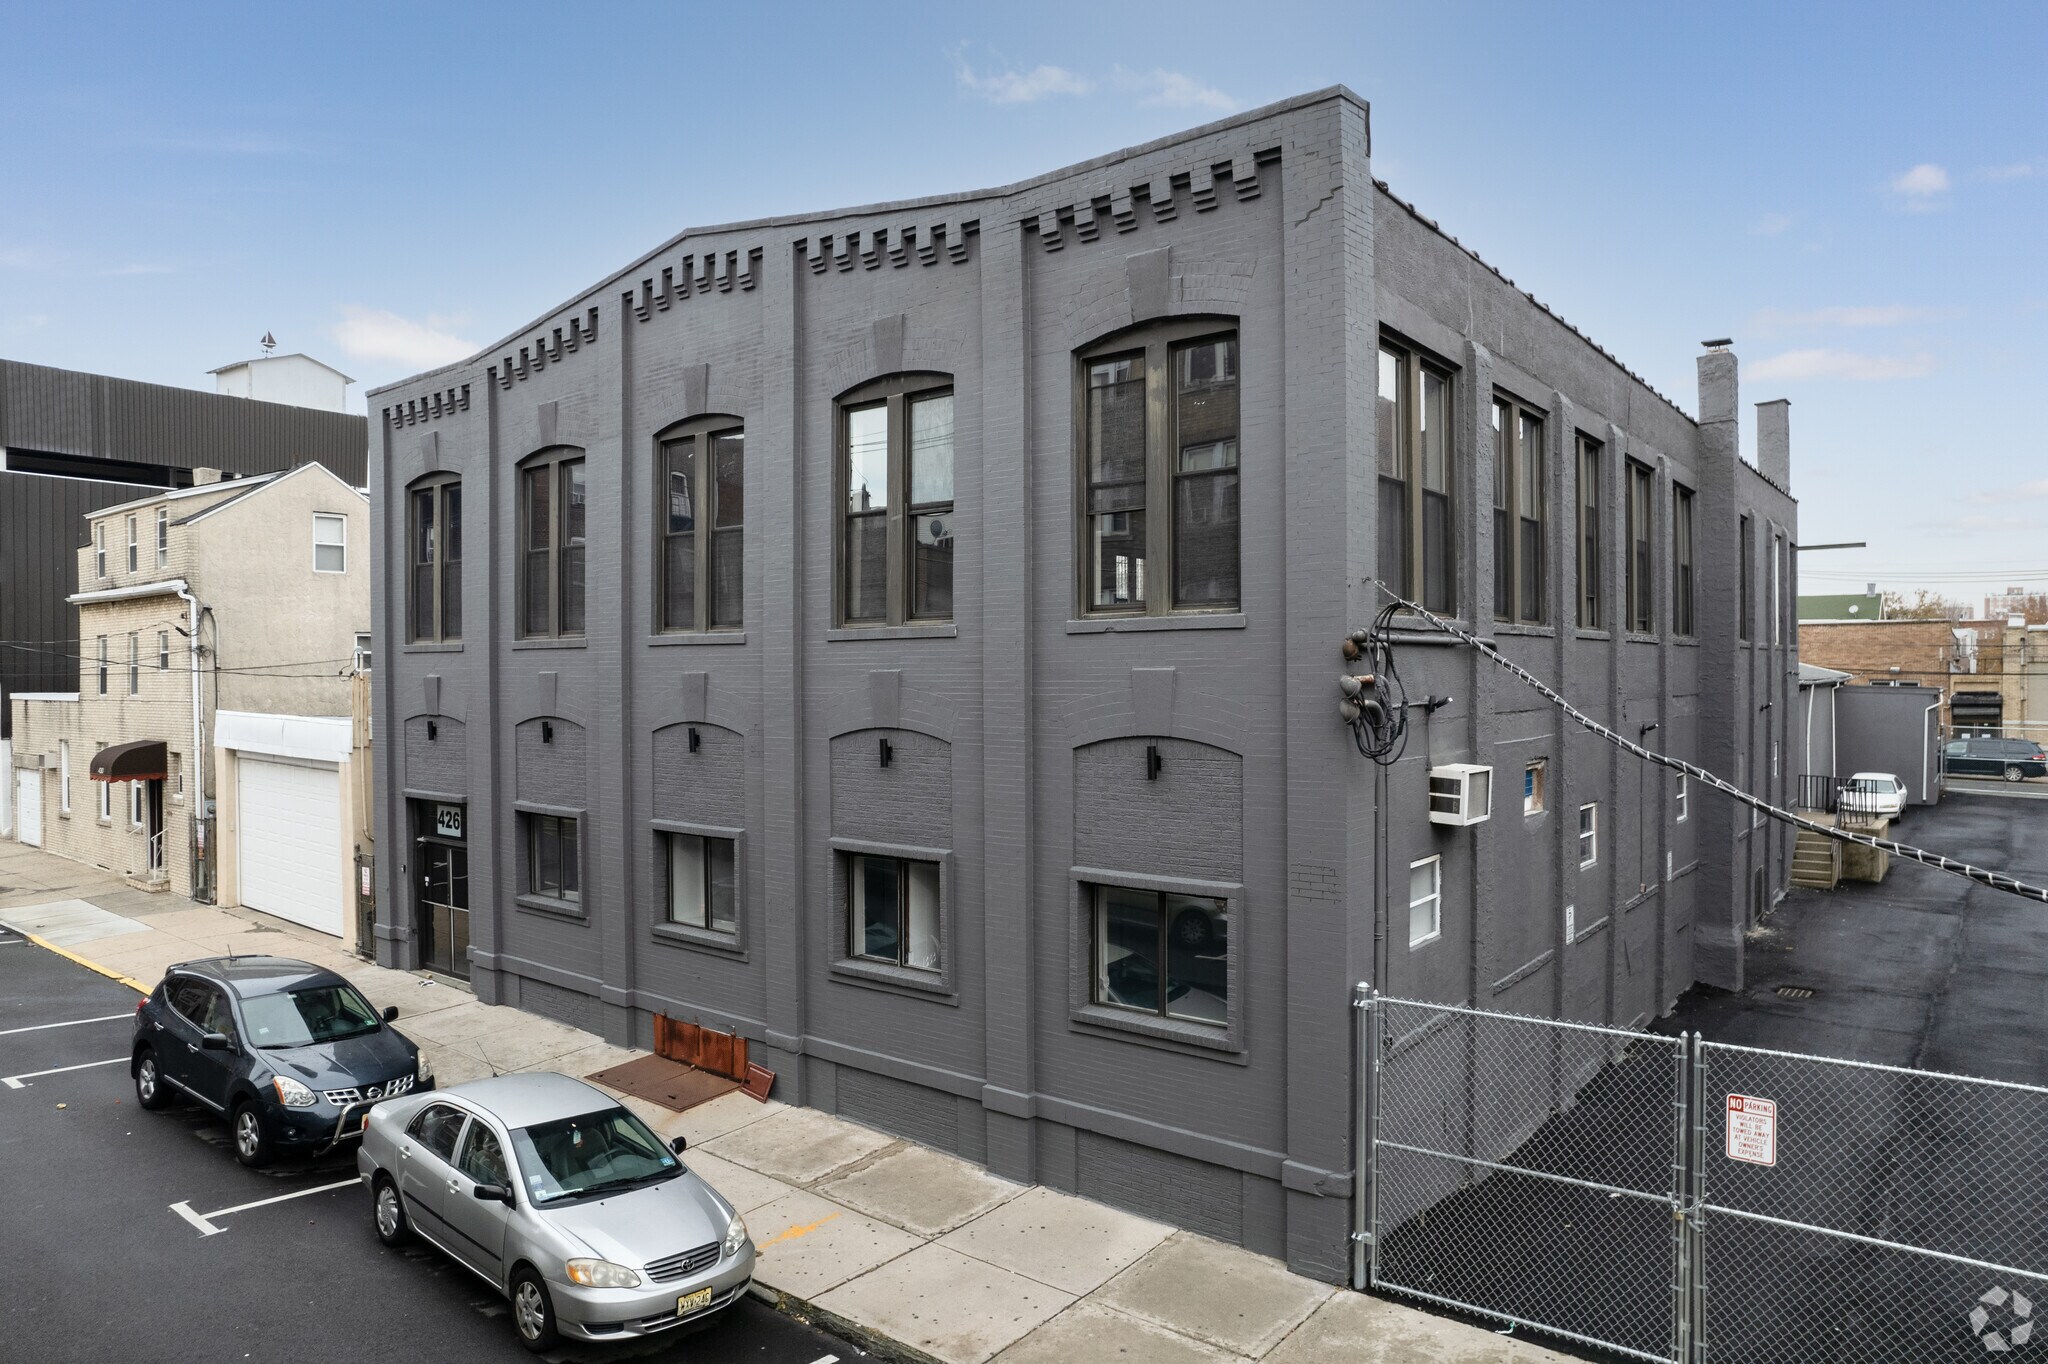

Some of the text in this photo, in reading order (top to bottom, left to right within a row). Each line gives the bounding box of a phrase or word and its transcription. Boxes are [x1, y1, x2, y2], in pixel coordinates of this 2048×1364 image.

[438, 810, 460, 830] 426
[1730, 1097, 1772, 1113] NO PARKING
[1736, 1114, 1766, 1124] VIOLATORS
[1733, 1127, 1752, 1135] TOWED
[1744, 1137, 1767, 1145] VEHICLE
[1738, 1148, 1763, 1157] EXPENSE
